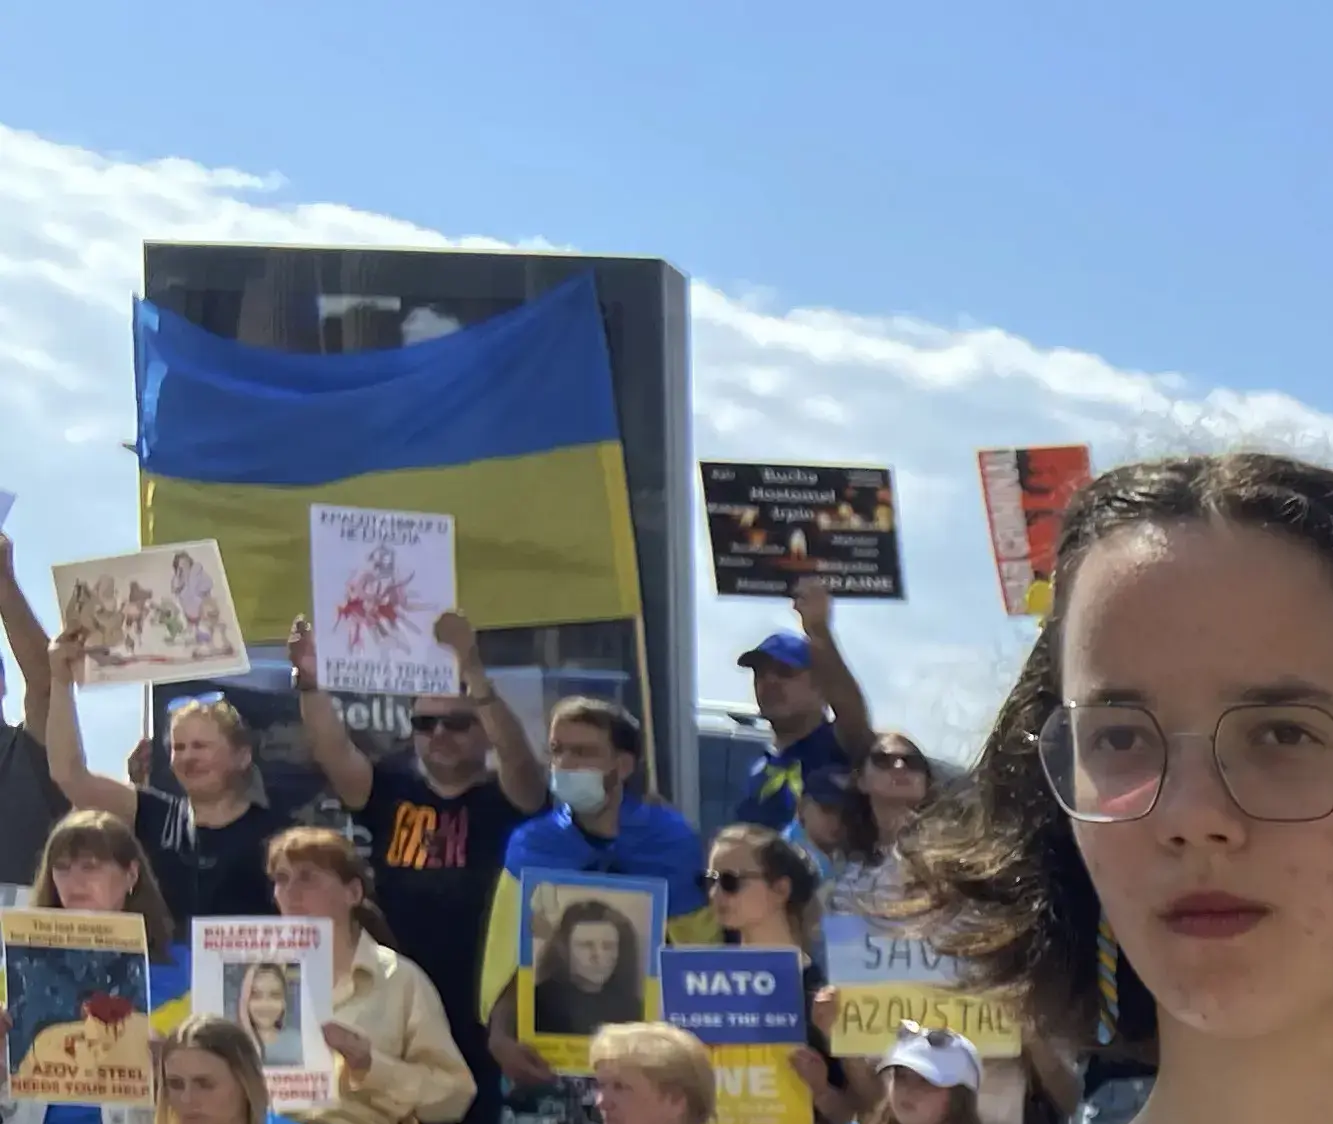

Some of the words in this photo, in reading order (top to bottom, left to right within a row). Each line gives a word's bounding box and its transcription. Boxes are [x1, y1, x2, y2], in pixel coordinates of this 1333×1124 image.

[204, 926, 257, 936] KILLED
[263, 926, 281, 936] BY
[291, 925, 319, 936] THE
[204, 939, 270, 950] RUSSIAN
[277, 939, 319, 950] ARMY
[686, 970, 776, 996] NATO
[669, 1012, 723, 1028] CLOSE
[727, 1012, 759, 1027] THE
[764, 1013, 798, 1027] SKY
[33, 1062, 79, 1079] AZOV
[98, 1066, 146, 1080] STEEL
[11, 1079, 60, 1093] NEEDS
[64, 1081, 107, 1095] YOUR
